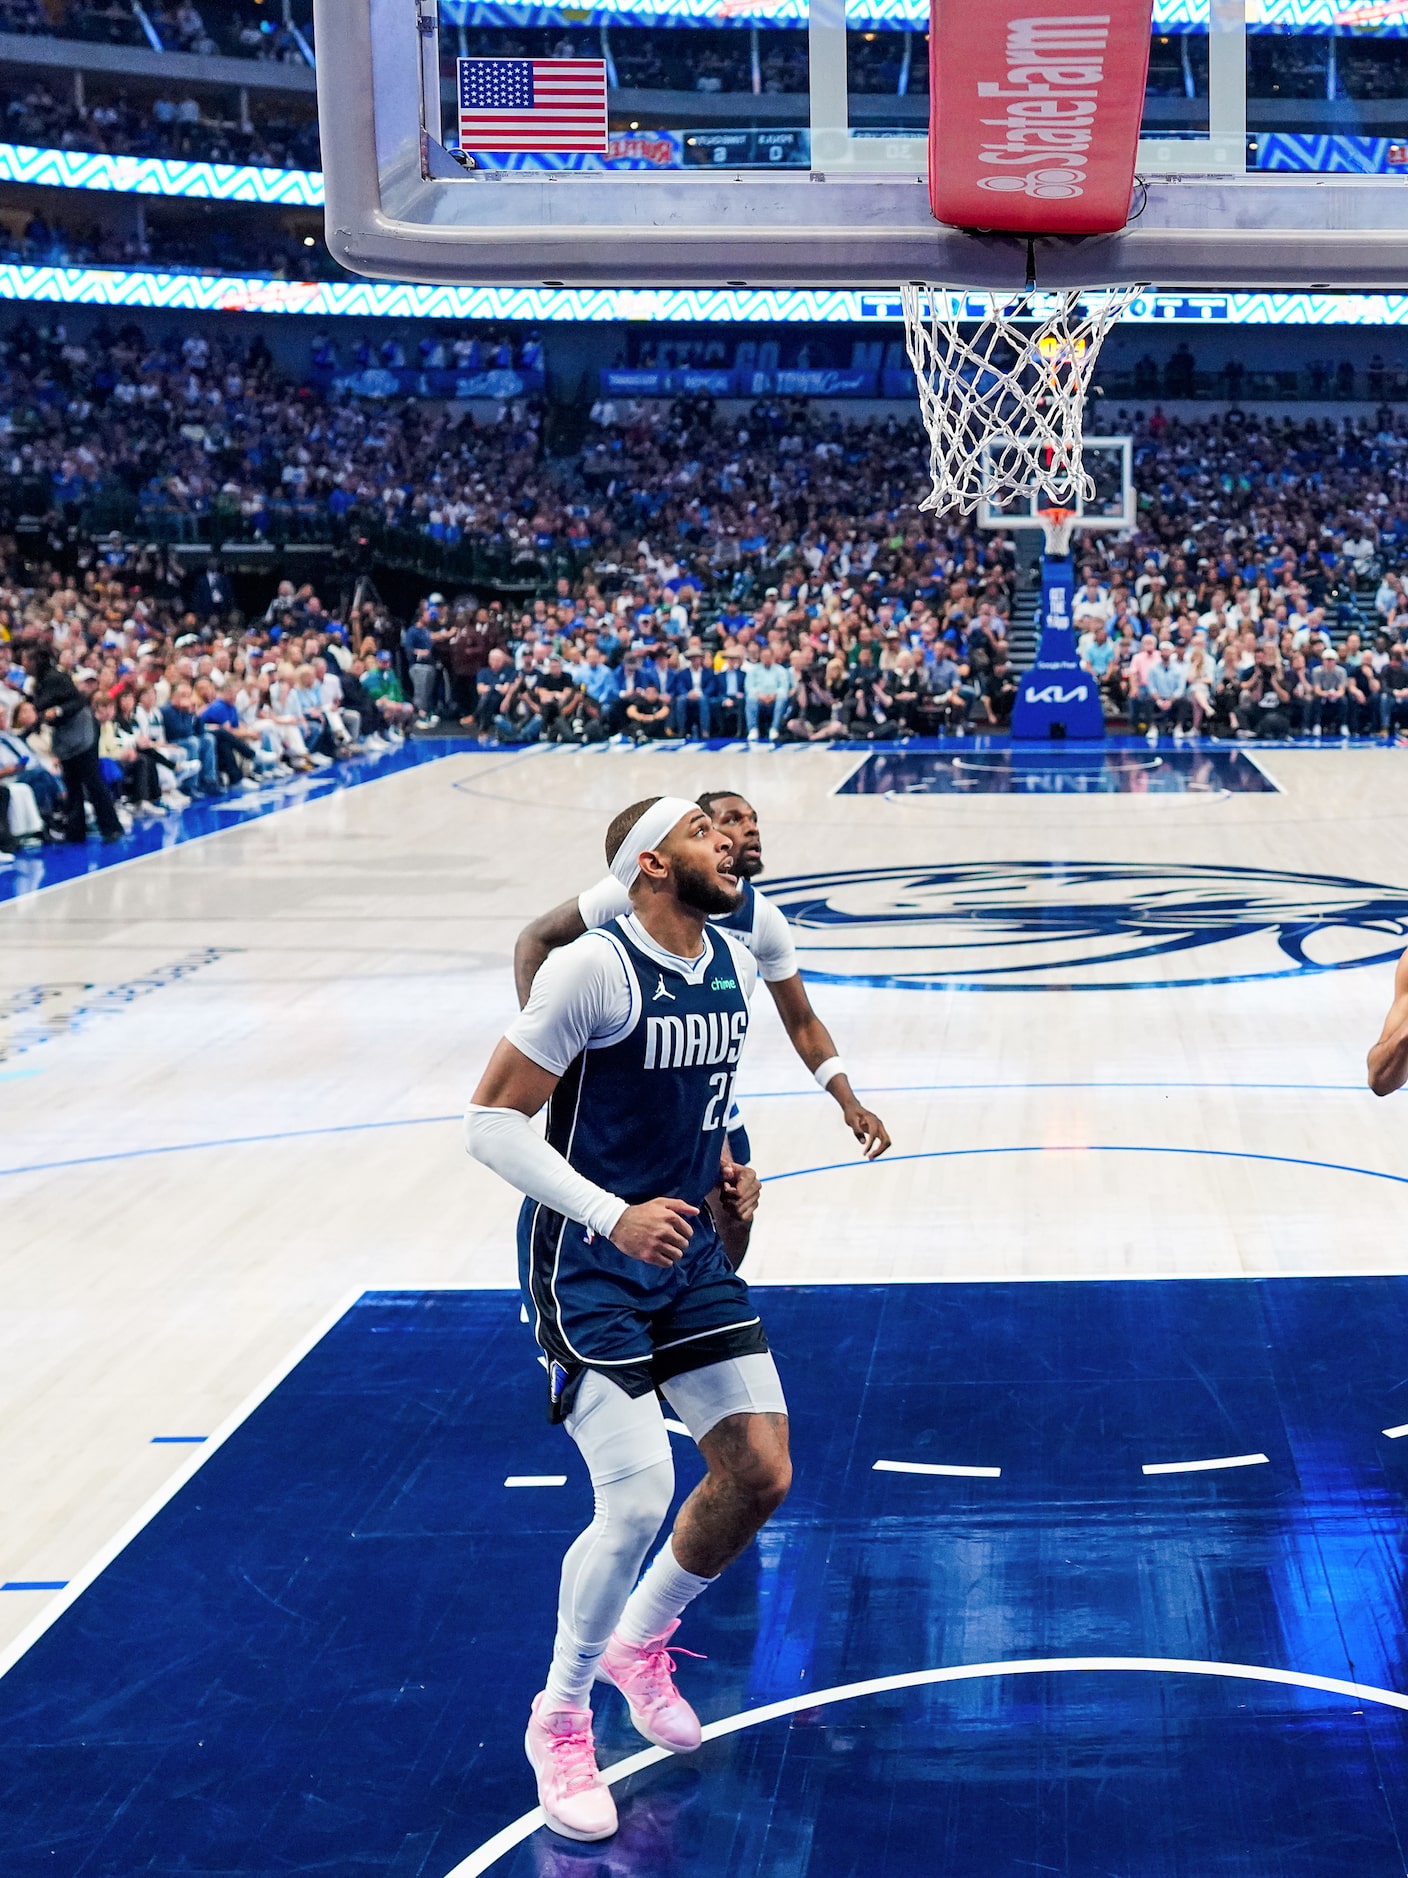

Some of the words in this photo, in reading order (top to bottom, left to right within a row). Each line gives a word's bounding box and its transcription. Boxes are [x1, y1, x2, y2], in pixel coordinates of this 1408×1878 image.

[1025, 685, 1088, 703] KIA
[711, 977, 737, 991] chime
[643, 1011, 747, 1070] MAVS
